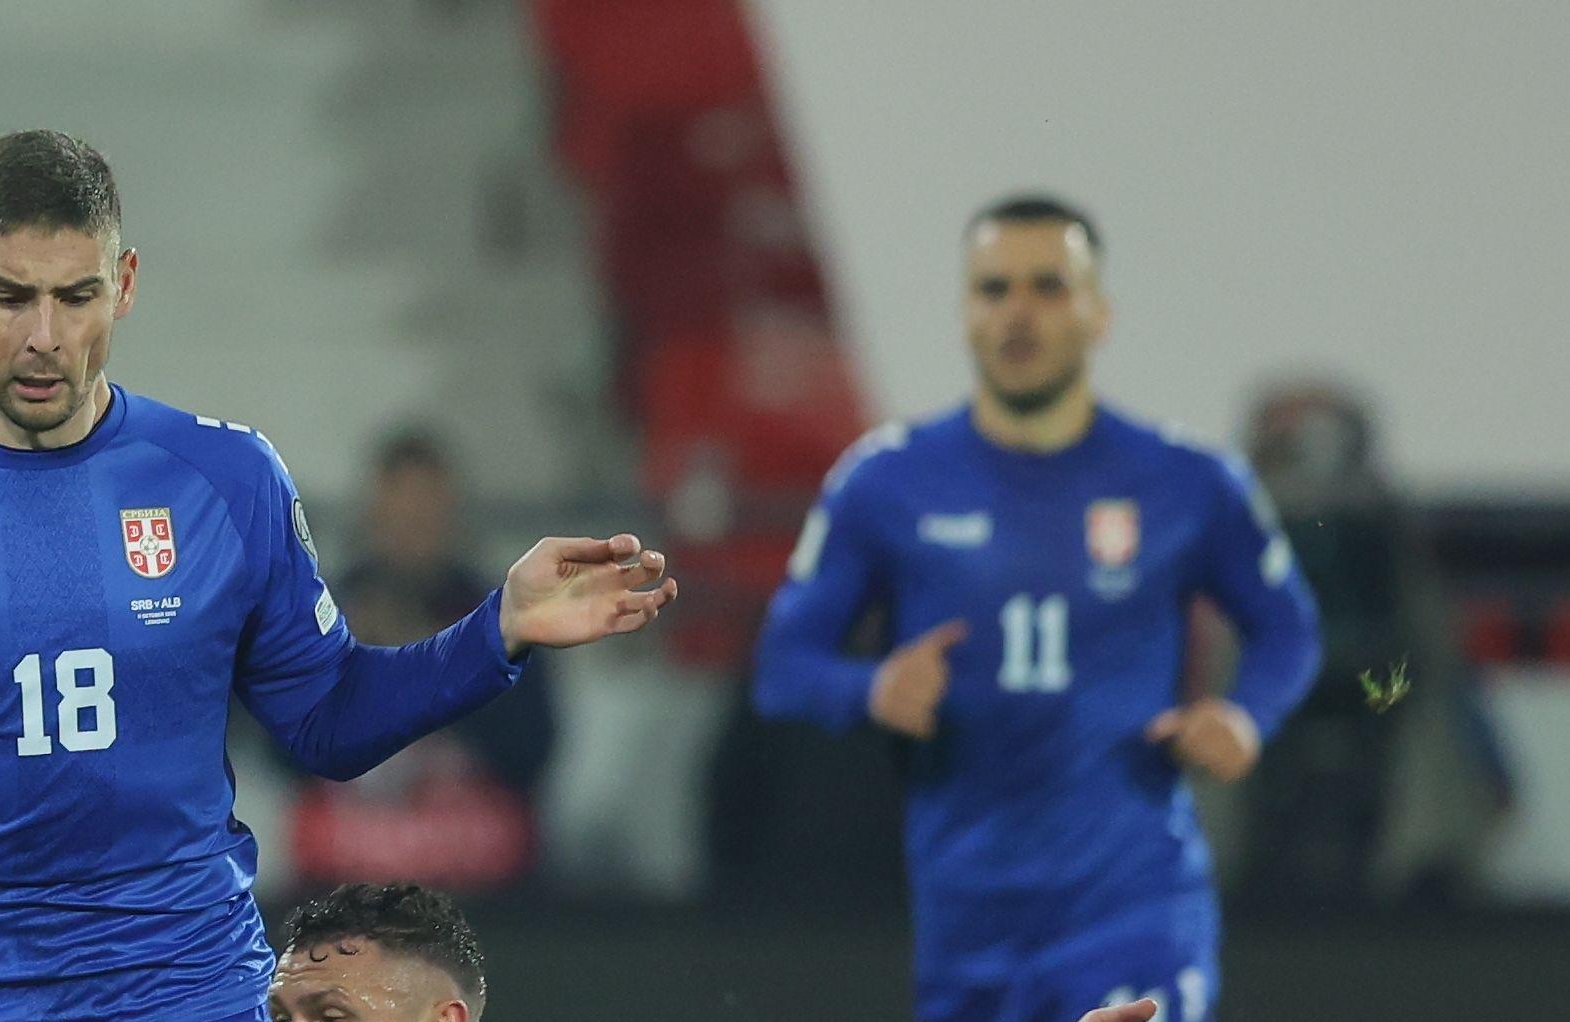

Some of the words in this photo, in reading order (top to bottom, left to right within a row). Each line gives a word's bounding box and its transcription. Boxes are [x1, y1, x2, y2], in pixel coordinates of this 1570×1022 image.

[130, 599, 154, 611] SRB
[160, 596, 181, 609] ALB
[997, 591, 1073, 692] 11
[13, 647, 117, 757] 18
